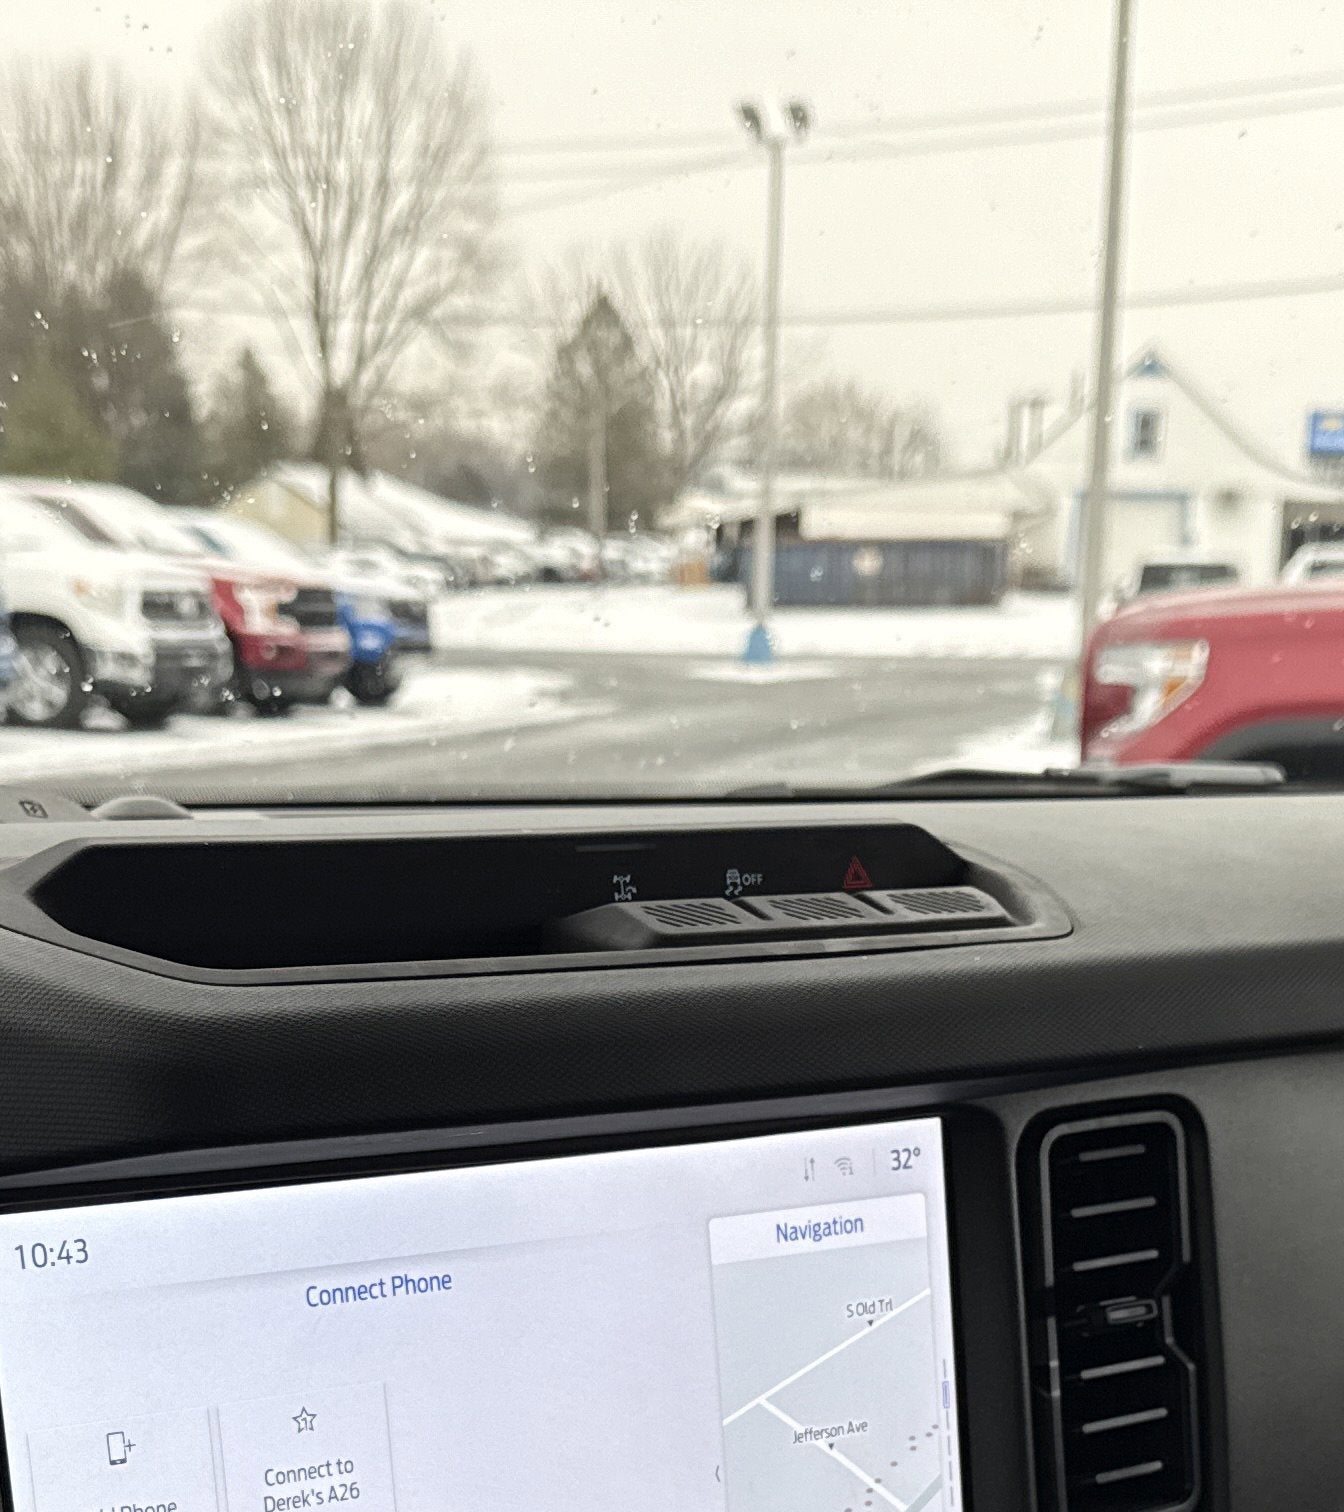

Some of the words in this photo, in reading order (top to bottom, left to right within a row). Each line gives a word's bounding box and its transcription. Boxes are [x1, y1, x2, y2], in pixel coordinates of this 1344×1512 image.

[741, 873, 764, 886] OFF
[775, 1216, 864, 1243] Navigation
[14, 1238, 90, 1270] 10:43
[305, 1278, 387, 1308] Connect
[390, 1271, 453, 1297] Phone
[846, 1303, 855, 1319] S
[855, 1300, 876, 1317] Old
[792, 1422, 845, 1445] Jefferson
[846, 1419, 869, 1436] Ave
[263, 1460, 332, 1488] Connect
[334, 1457, 355, 1478] to
[327, 1481, 361, 1504] A26
